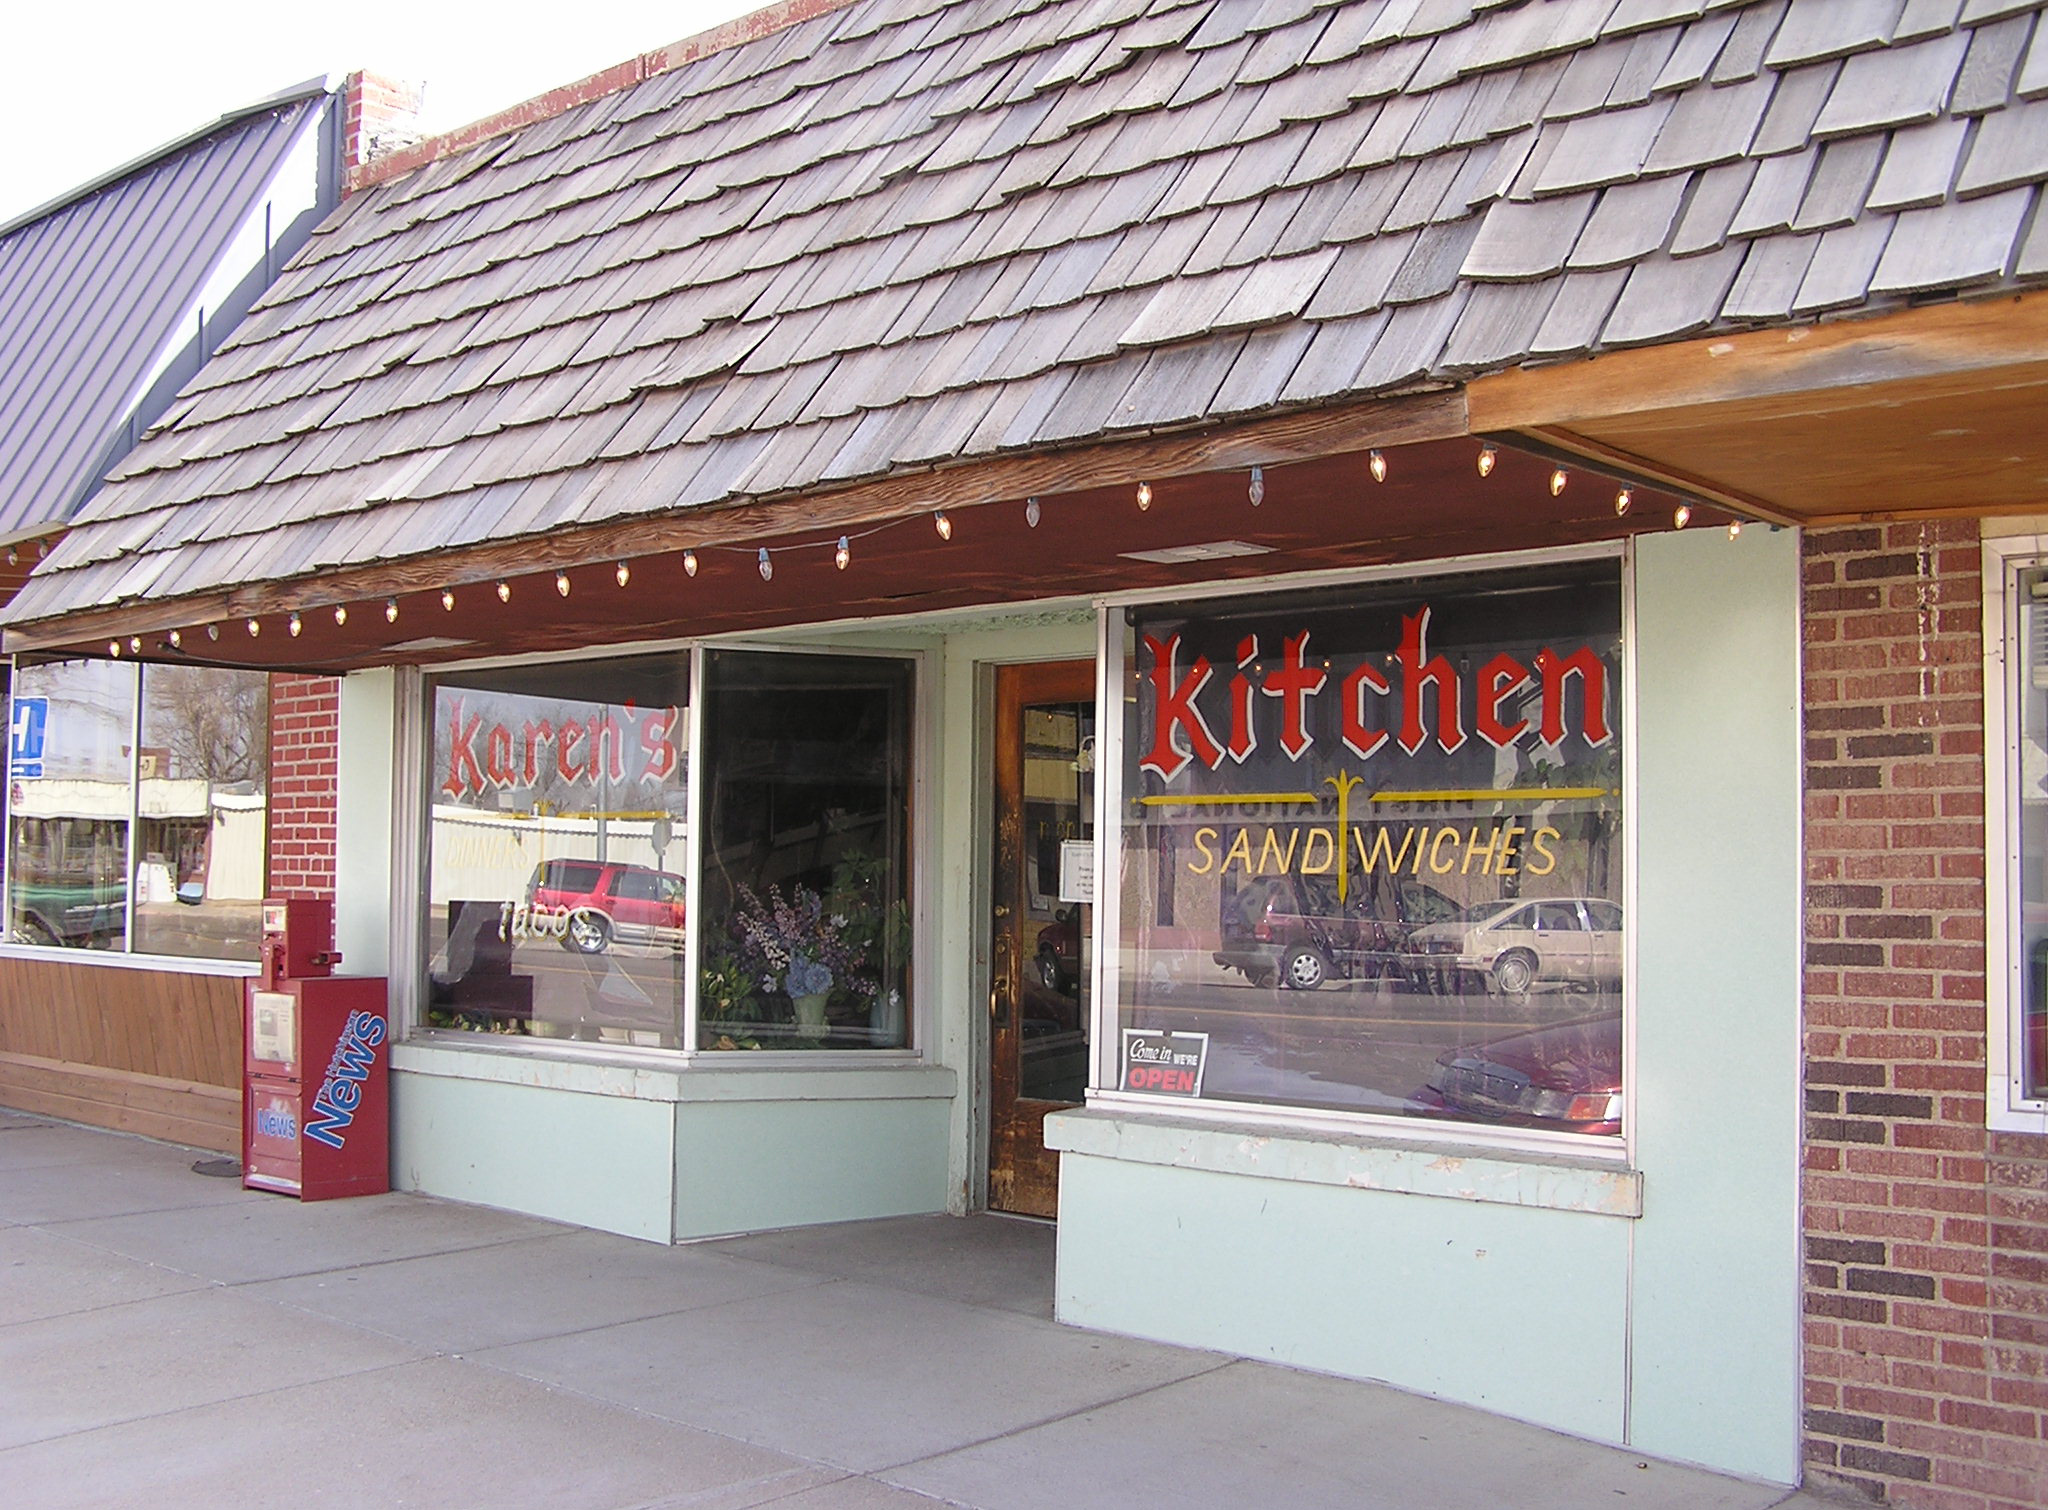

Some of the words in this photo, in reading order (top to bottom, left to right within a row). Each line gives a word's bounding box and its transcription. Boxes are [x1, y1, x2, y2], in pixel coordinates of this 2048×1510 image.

[1130, 1038, 1160, 1060] Come
[1160, 1046, 1172, 1061] in
[1173, 1053, 1198, 1066] WE'RE
[303, 1010, 387, 1150] News
[1129, 1066, 1196, 1092] OPEN
[257, 1108, 297, 1140] News
